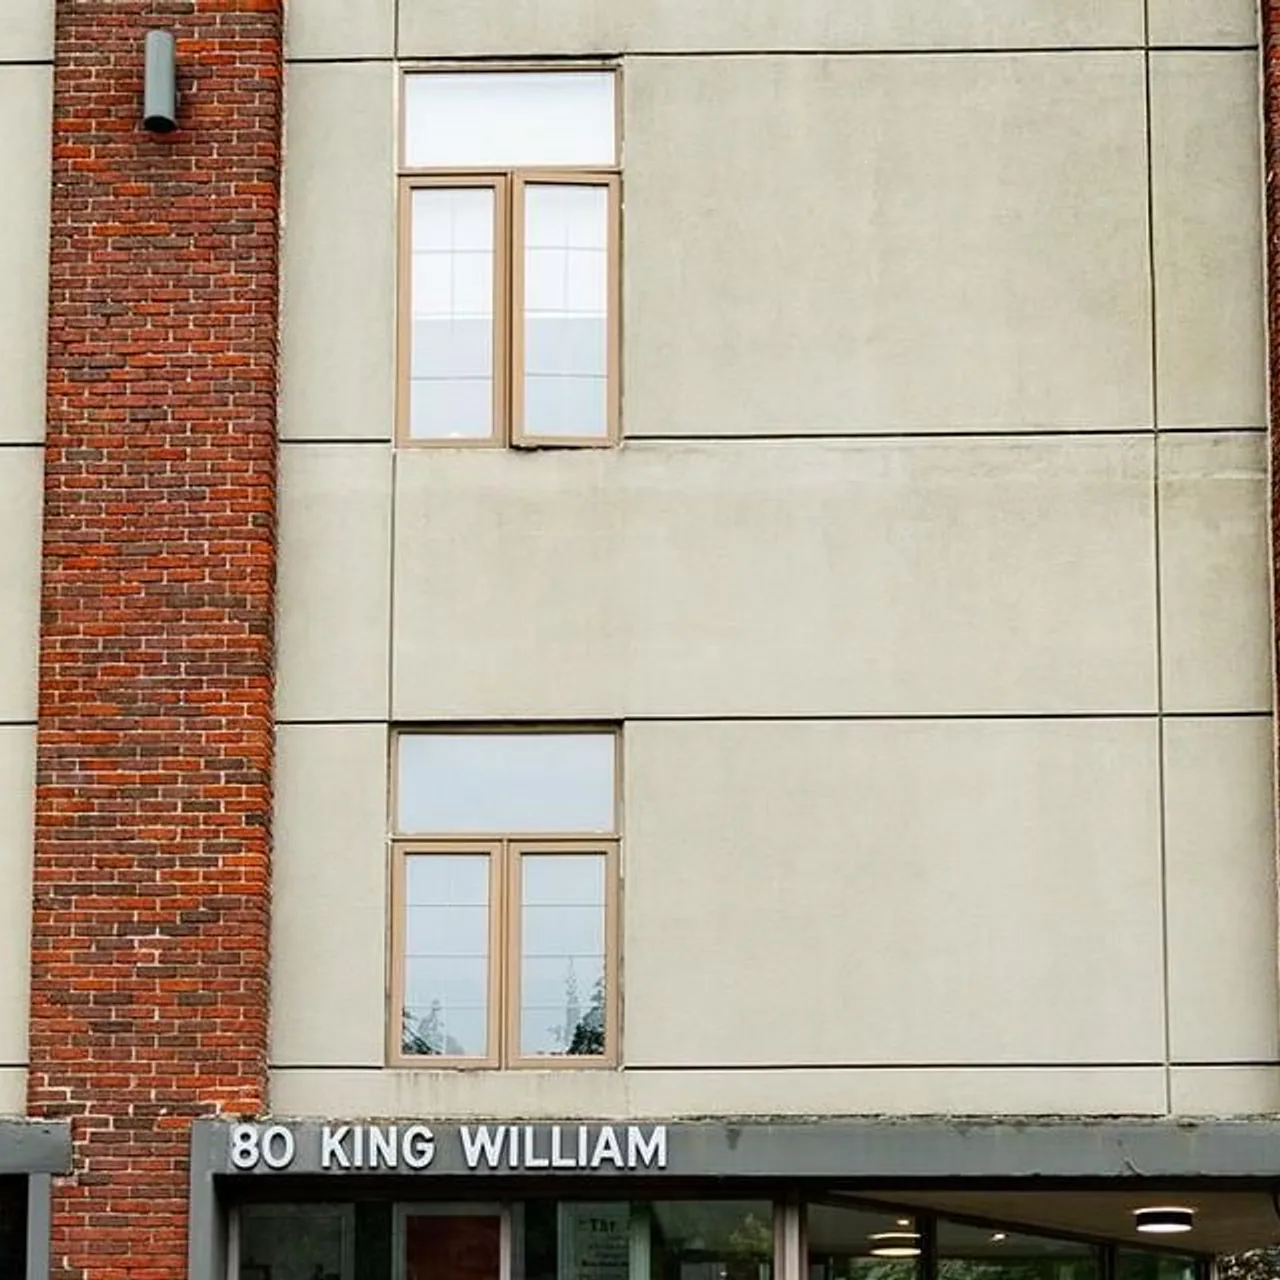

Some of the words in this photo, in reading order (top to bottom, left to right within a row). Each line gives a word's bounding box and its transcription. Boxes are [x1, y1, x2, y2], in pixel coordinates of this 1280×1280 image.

[231, 1124, 296, 1169] 80
[322, 1124, 436, 1169] KING
[461, 1124, 668, 1169] WILLIAM
